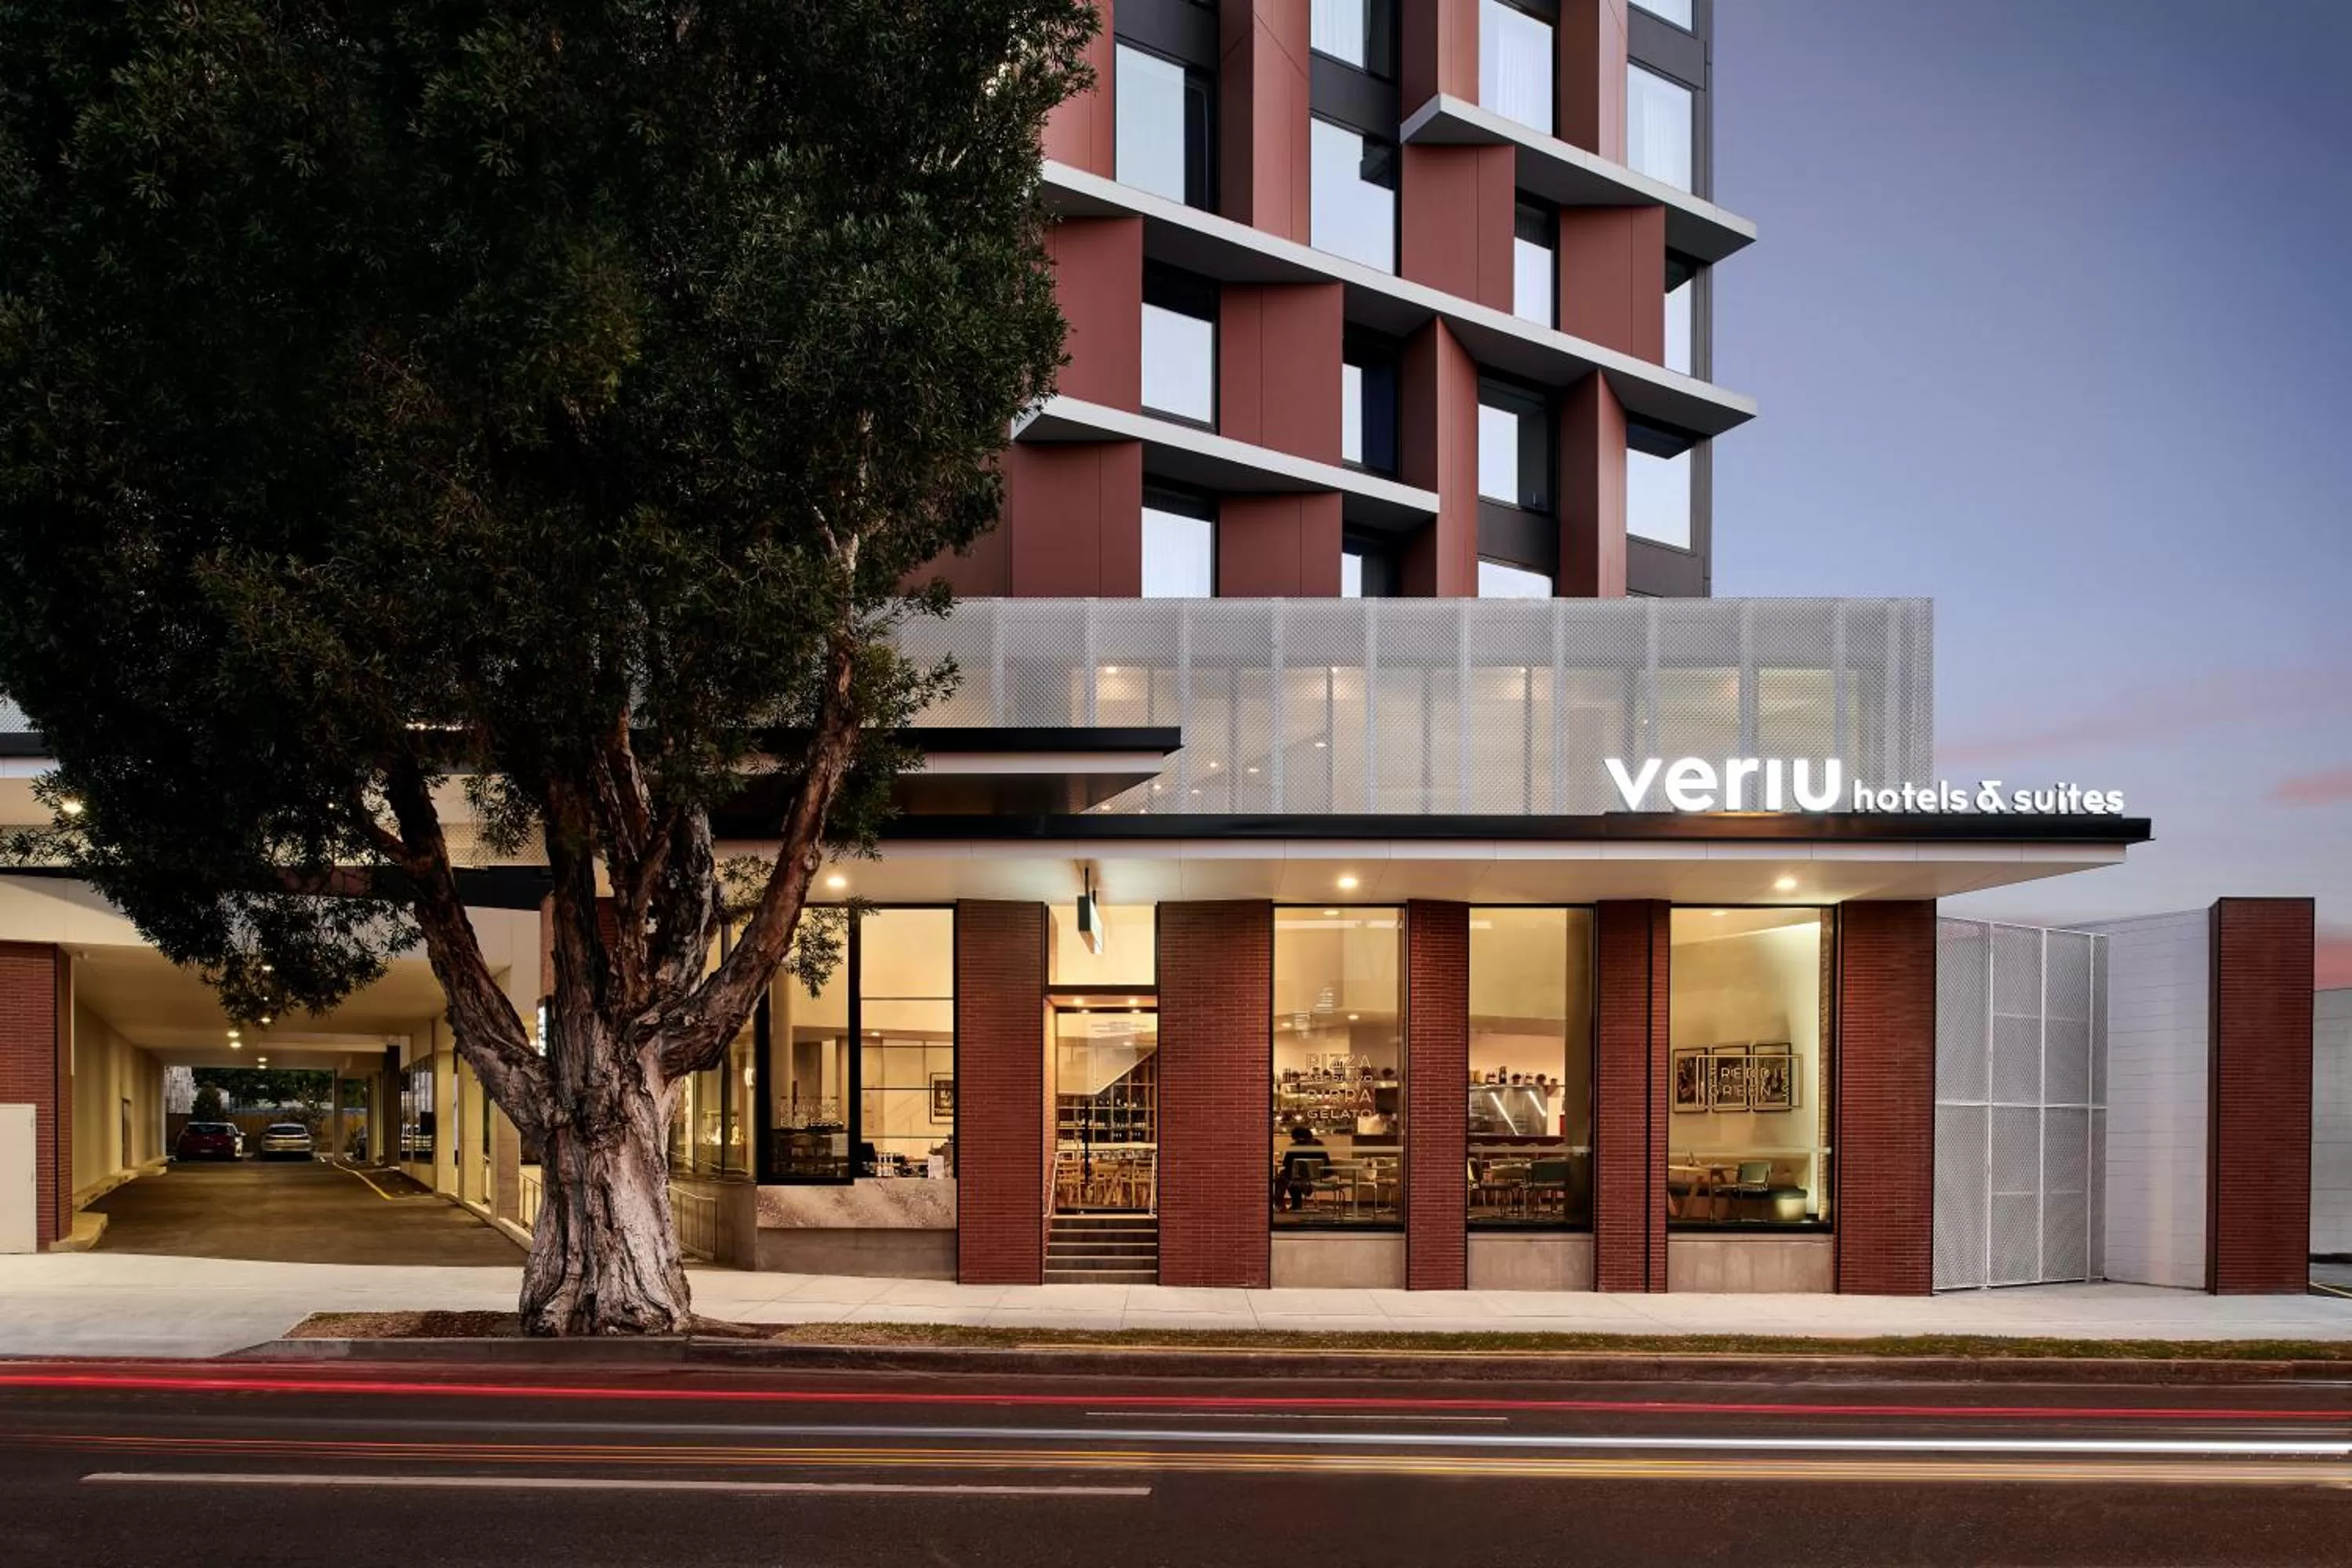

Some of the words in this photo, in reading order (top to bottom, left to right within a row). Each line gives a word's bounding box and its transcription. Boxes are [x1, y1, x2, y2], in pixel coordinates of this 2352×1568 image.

[1853, 779, 1969, 811] hotels
[1976, 780, 2006, 811] &
[2012, 782, 2125, 814] suites
[1305, 1053, 1371, 1069] PIZZA
[1709, 1067, 1788, 1079] FREDDIE
[1307, 1089, 1371, 1103] BIRRA
[1307, 1109, 1373, 1119] GELATO
